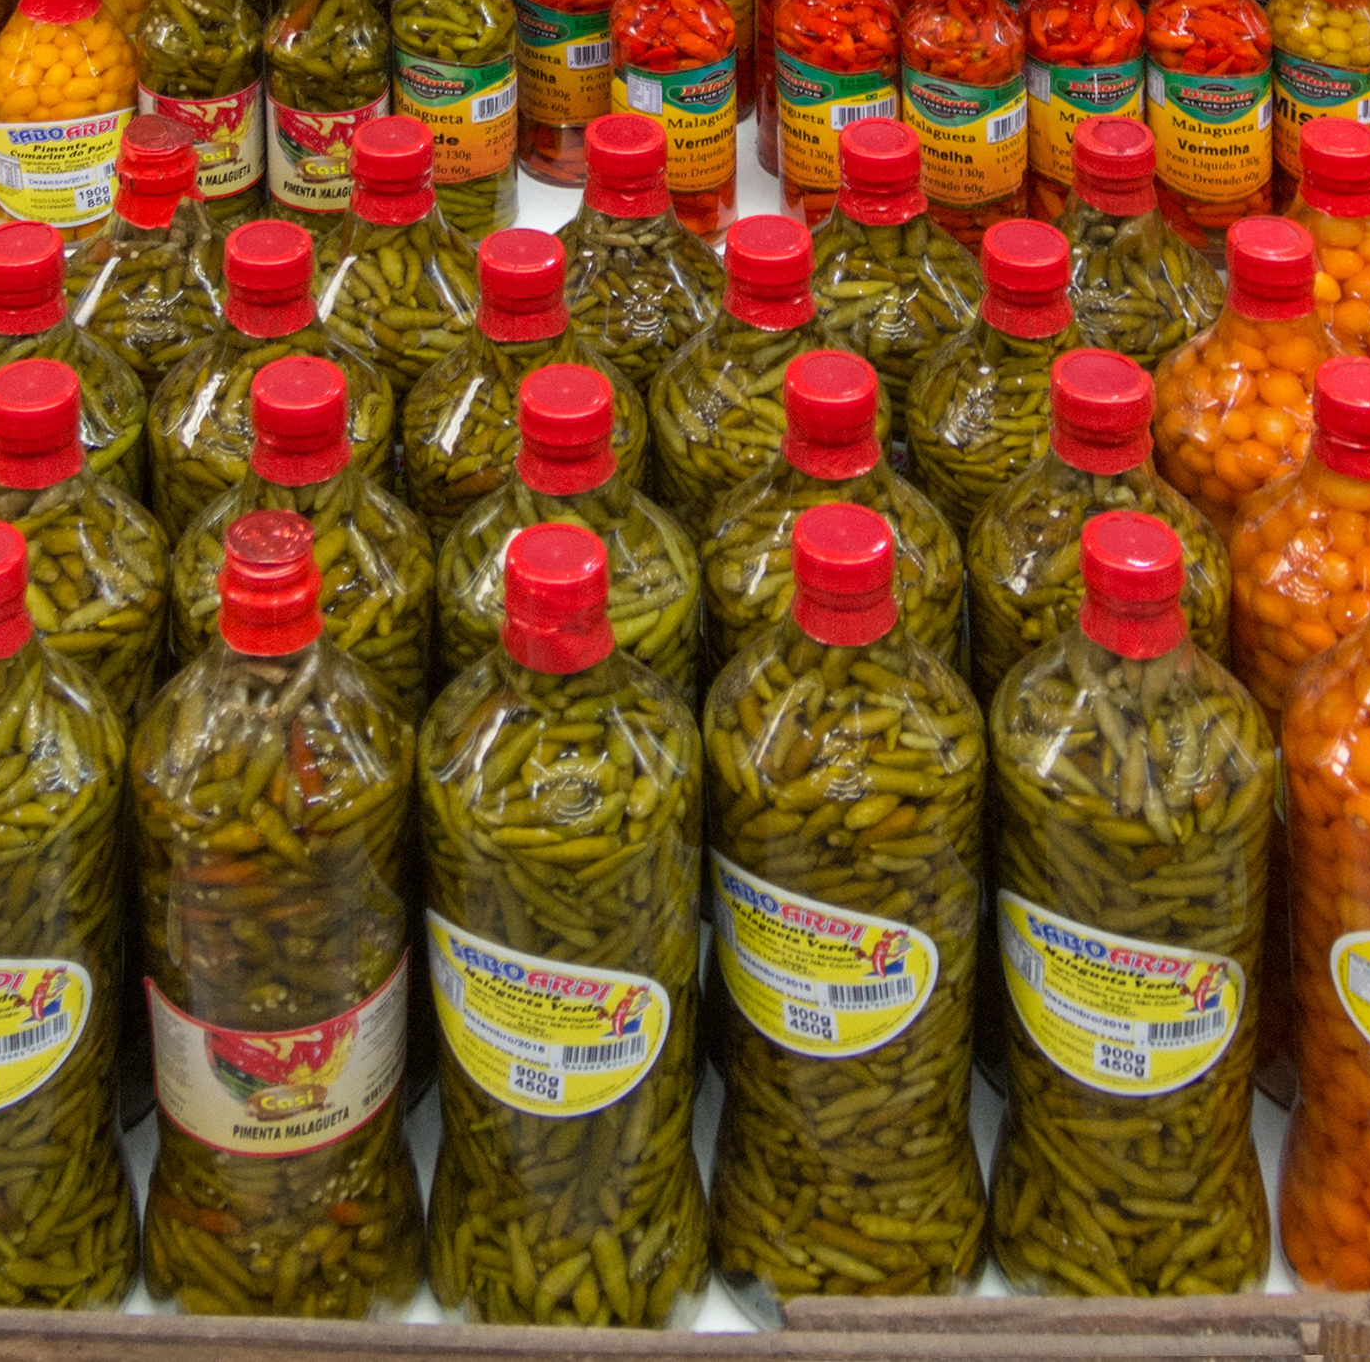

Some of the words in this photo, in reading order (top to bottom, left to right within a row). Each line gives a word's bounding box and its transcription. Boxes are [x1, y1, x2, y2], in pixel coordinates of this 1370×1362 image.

[1183, 96, 1255, 110] ALIMENTOS
[8, 118, 119, 144] SABOARDI
[904, 108, 977, 144] Malagueta
[1171, 114, 1255, 137] Malagueta
[1177, 138, 1251, 156] Vermelha
[204, 164, 252, 187] MALAGUETA
[78, 188, 111, 200] 190g
[87, 196, 111, 209] 85g
[1026, 914, 1194, 979] SABOARDI
[787, 1006, 832, 1026] 900g
[789, 1020, 834, 1039] 450g
[1101, 1043, 1146, 1065] 900g
[512, 1064, 560, 1086] 900g
[260, 1089, 314, 1112] Casi
[513, 1080, 558, 1100] 450g
[232, 1124, 282, 1140] PIMENTA
[285, 1107, 351, 1139] MALAGUETA
